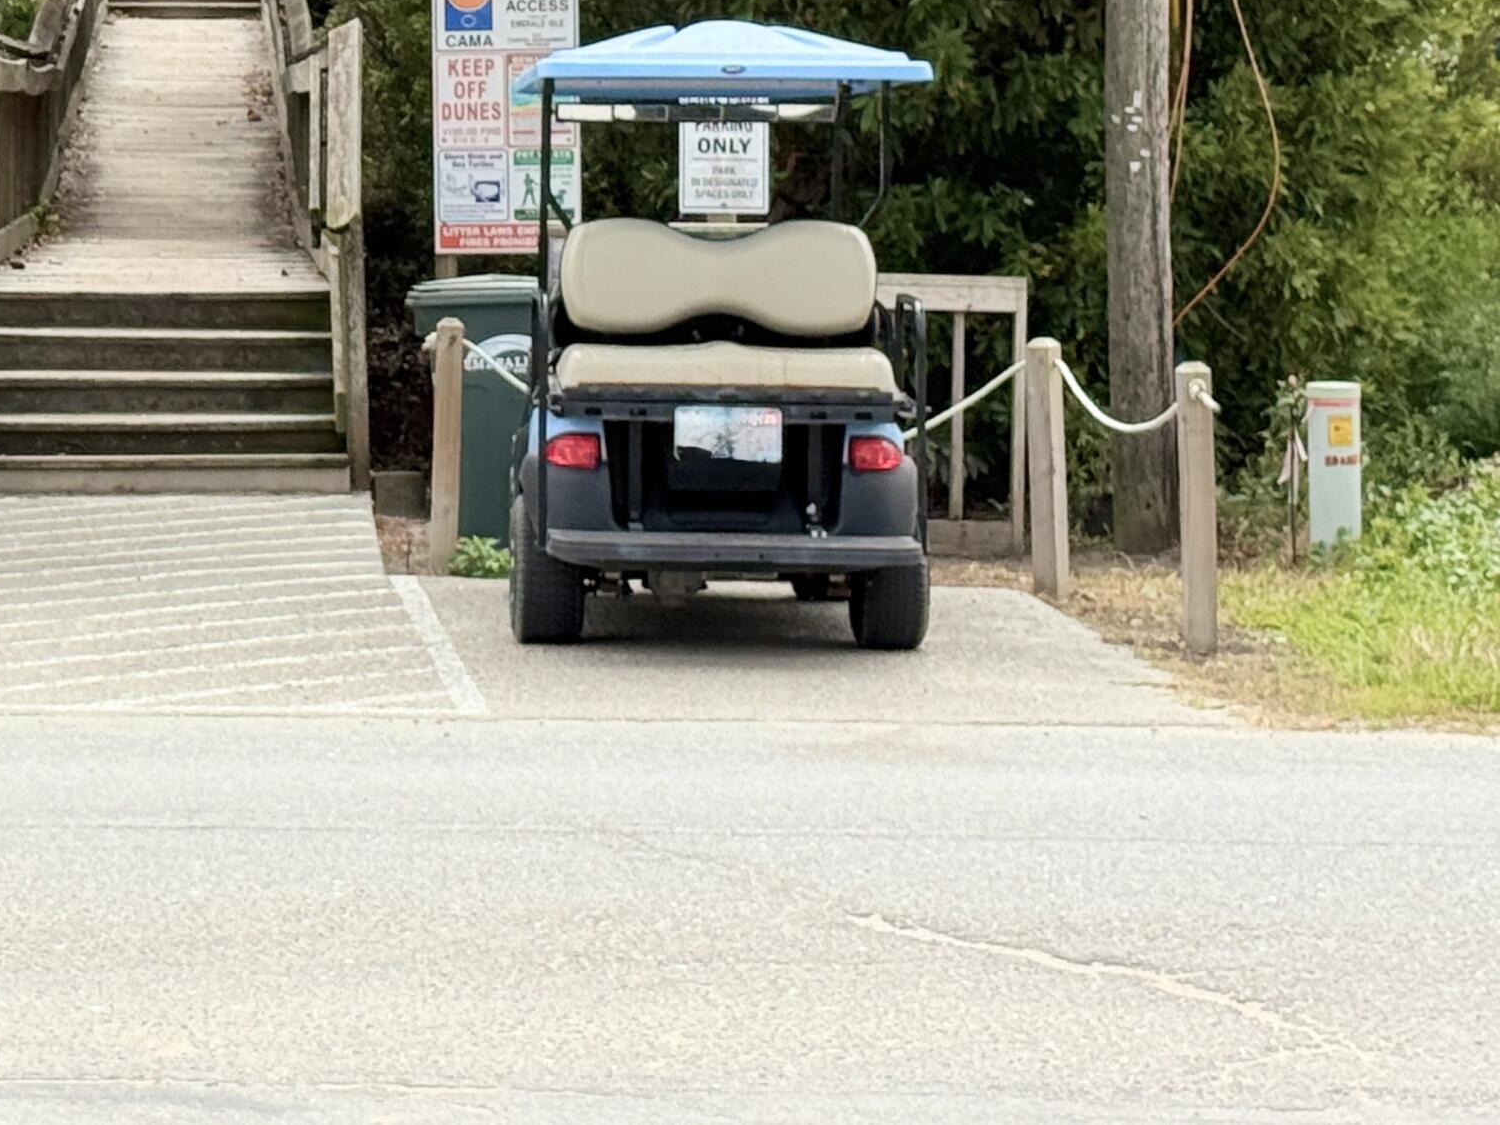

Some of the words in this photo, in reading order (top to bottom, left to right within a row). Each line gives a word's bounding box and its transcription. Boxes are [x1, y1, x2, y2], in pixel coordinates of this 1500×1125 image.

[506, 0, 569, 12] ACCESS
[445, 35, 493, 47] CAMA
[447, 59, 495, 76] KEEP
[453, 81, 487, 99] OFF
[442, 103, 502, 121] DUNES
[698, 137, 752, 154] ONLY
[712, 166, 736, 175] PARK
